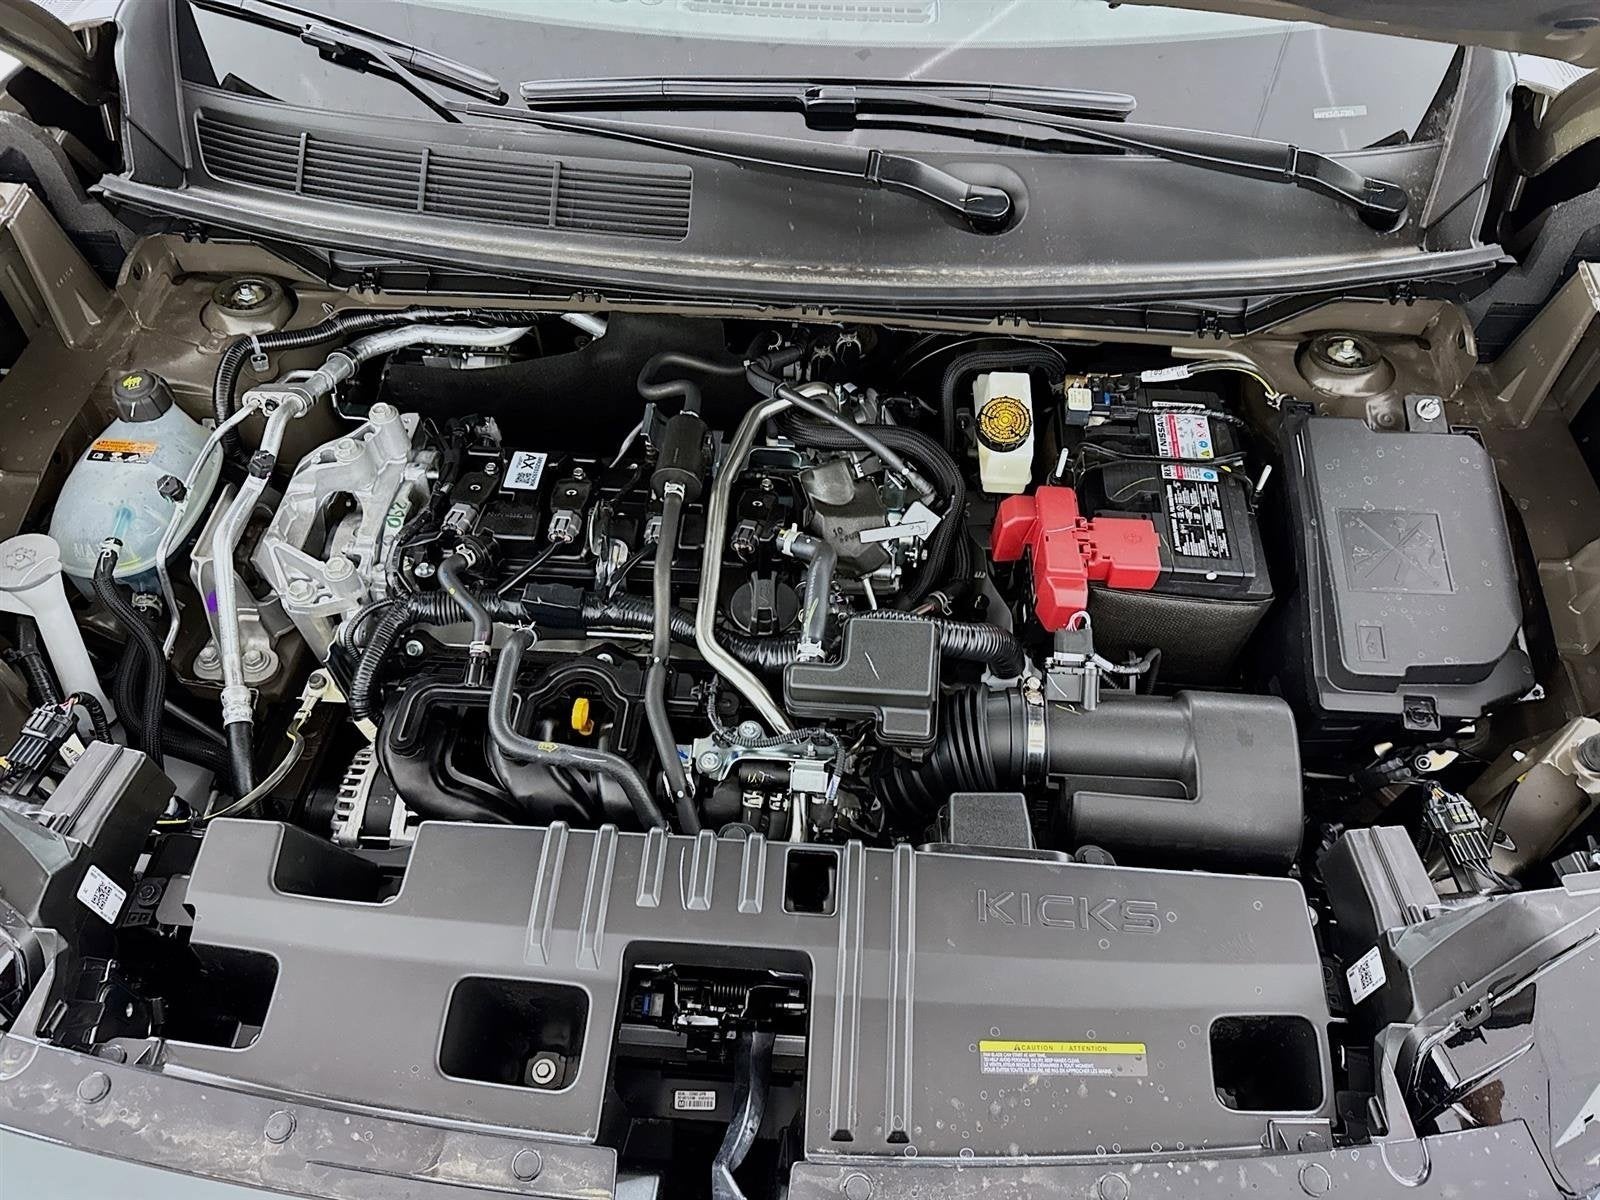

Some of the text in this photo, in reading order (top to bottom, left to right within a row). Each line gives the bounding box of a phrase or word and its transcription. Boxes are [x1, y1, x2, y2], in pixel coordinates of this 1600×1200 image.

[1156, 413, 1169, 448] NISSAN
[520, 453, 537, 469] AX
[977, 888, 1162, 935] KICKS
[1021, 1044, 1053, 1052] CAUTION
[1068, 1045, 1108, 1053] ATTENTION
